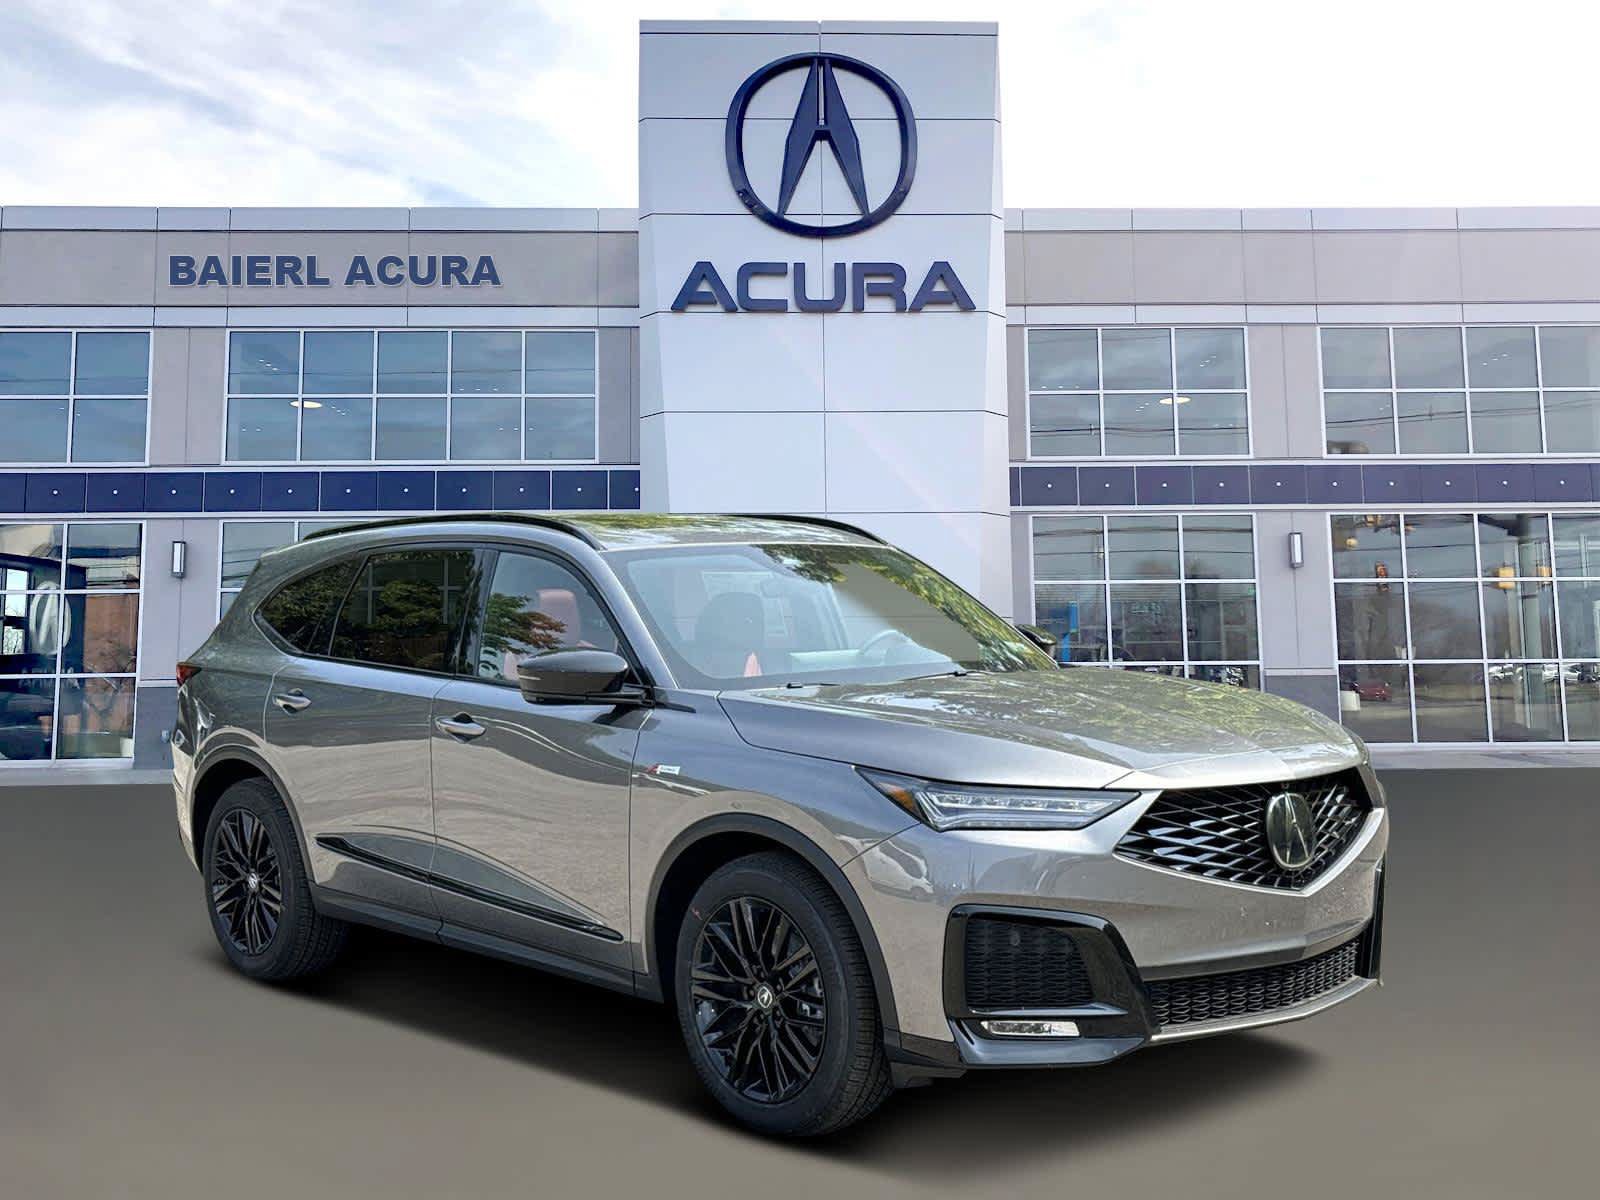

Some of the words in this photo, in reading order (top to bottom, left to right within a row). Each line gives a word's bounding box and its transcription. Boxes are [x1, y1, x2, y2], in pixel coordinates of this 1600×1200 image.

[169, 255, 330, 286] BAIERL
[343, 255, 501, 286] ACURA
[671, 261, 976, 313] ACURA
